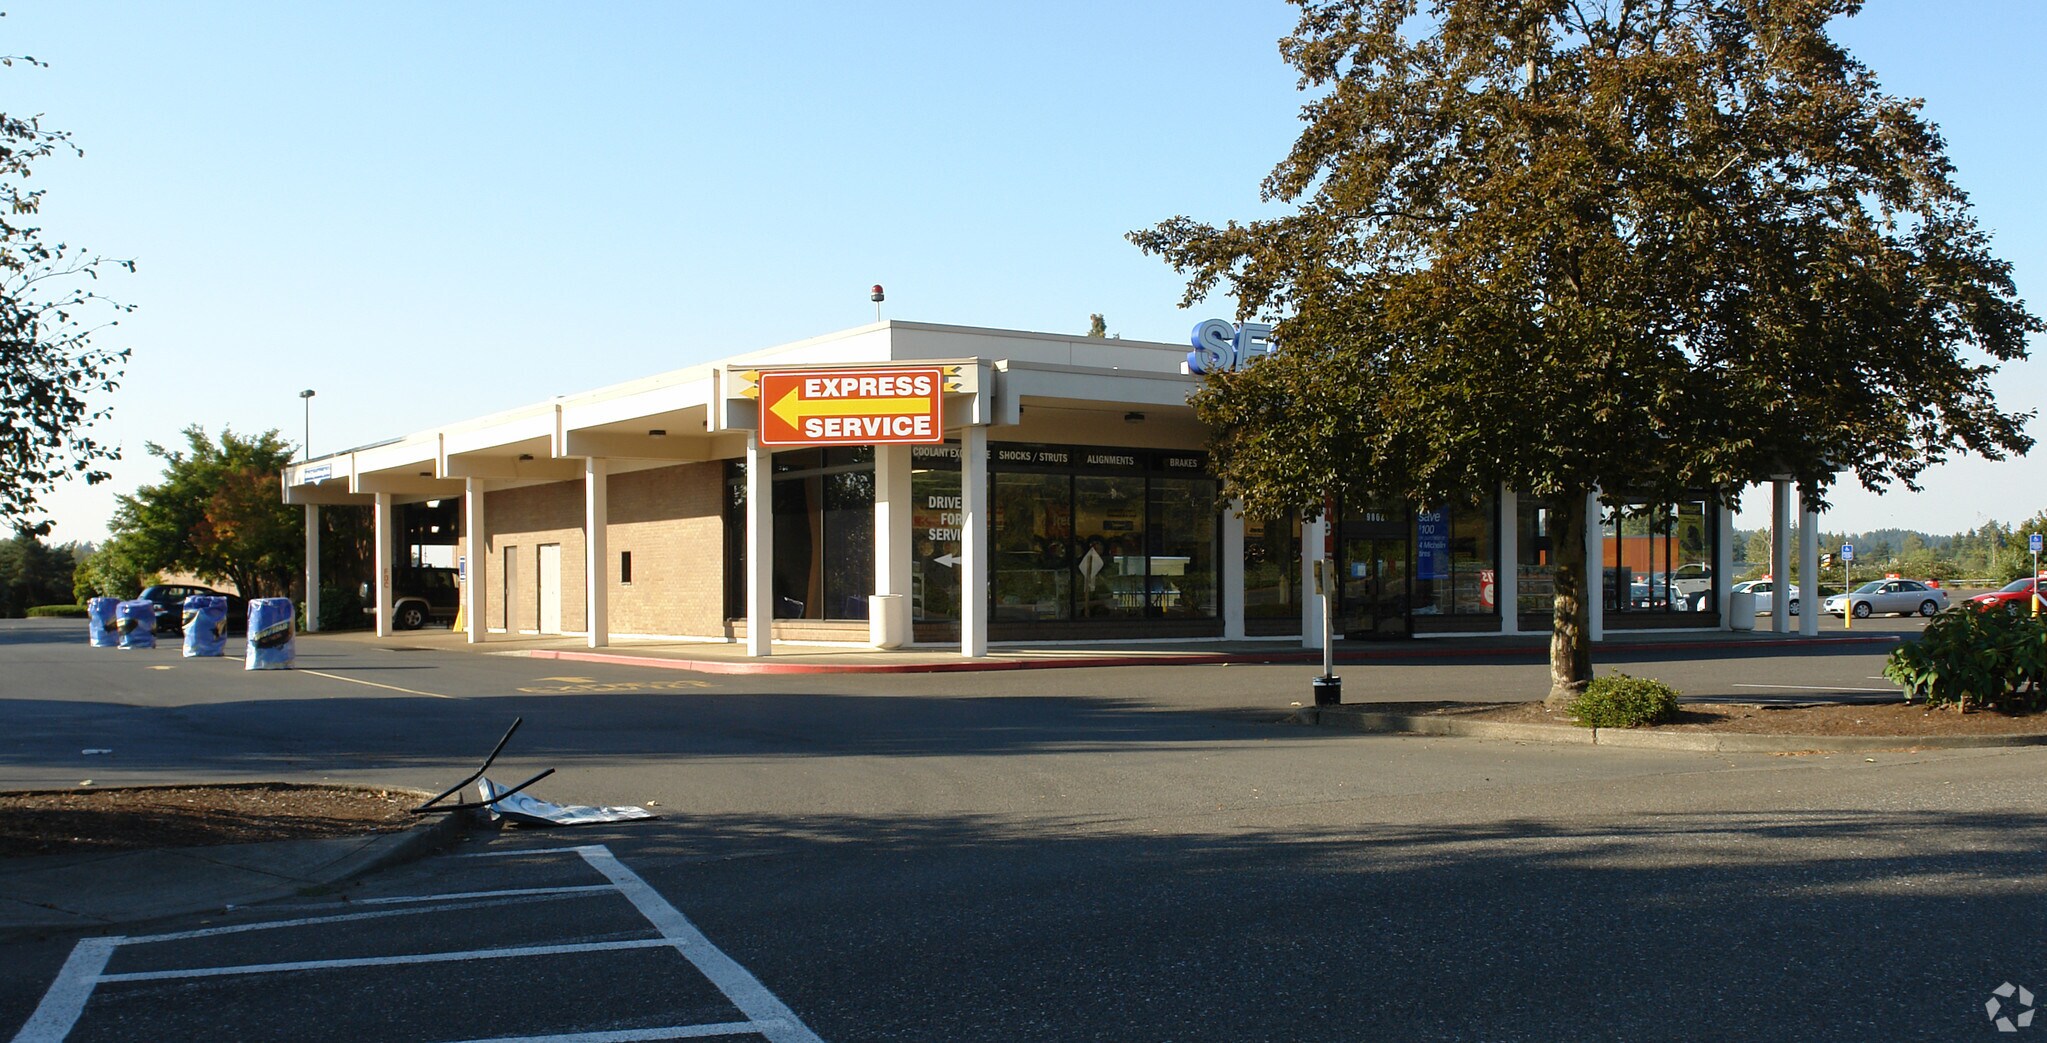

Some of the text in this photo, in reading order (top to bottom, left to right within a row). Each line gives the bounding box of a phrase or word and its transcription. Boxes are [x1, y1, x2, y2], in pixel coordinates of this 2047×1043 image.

[805, 376, 932, 398] EXPRESS
[805, 415, 931, 438] SERVICE
[912, 446, 950, 458] COOLANT
[998, 450, 1031, 461] SHOCKS
[1039, 452, 1068, 463] STRUTS
[1087, 455, 1134, 466] ALIGNMENTS
[1170, 458, 1198, 468] BRAKES
[928, 495, 962, 509] DRIVE
[940, 513, 962, 526] FOR
[928, 528, 961, 541] SERVI
